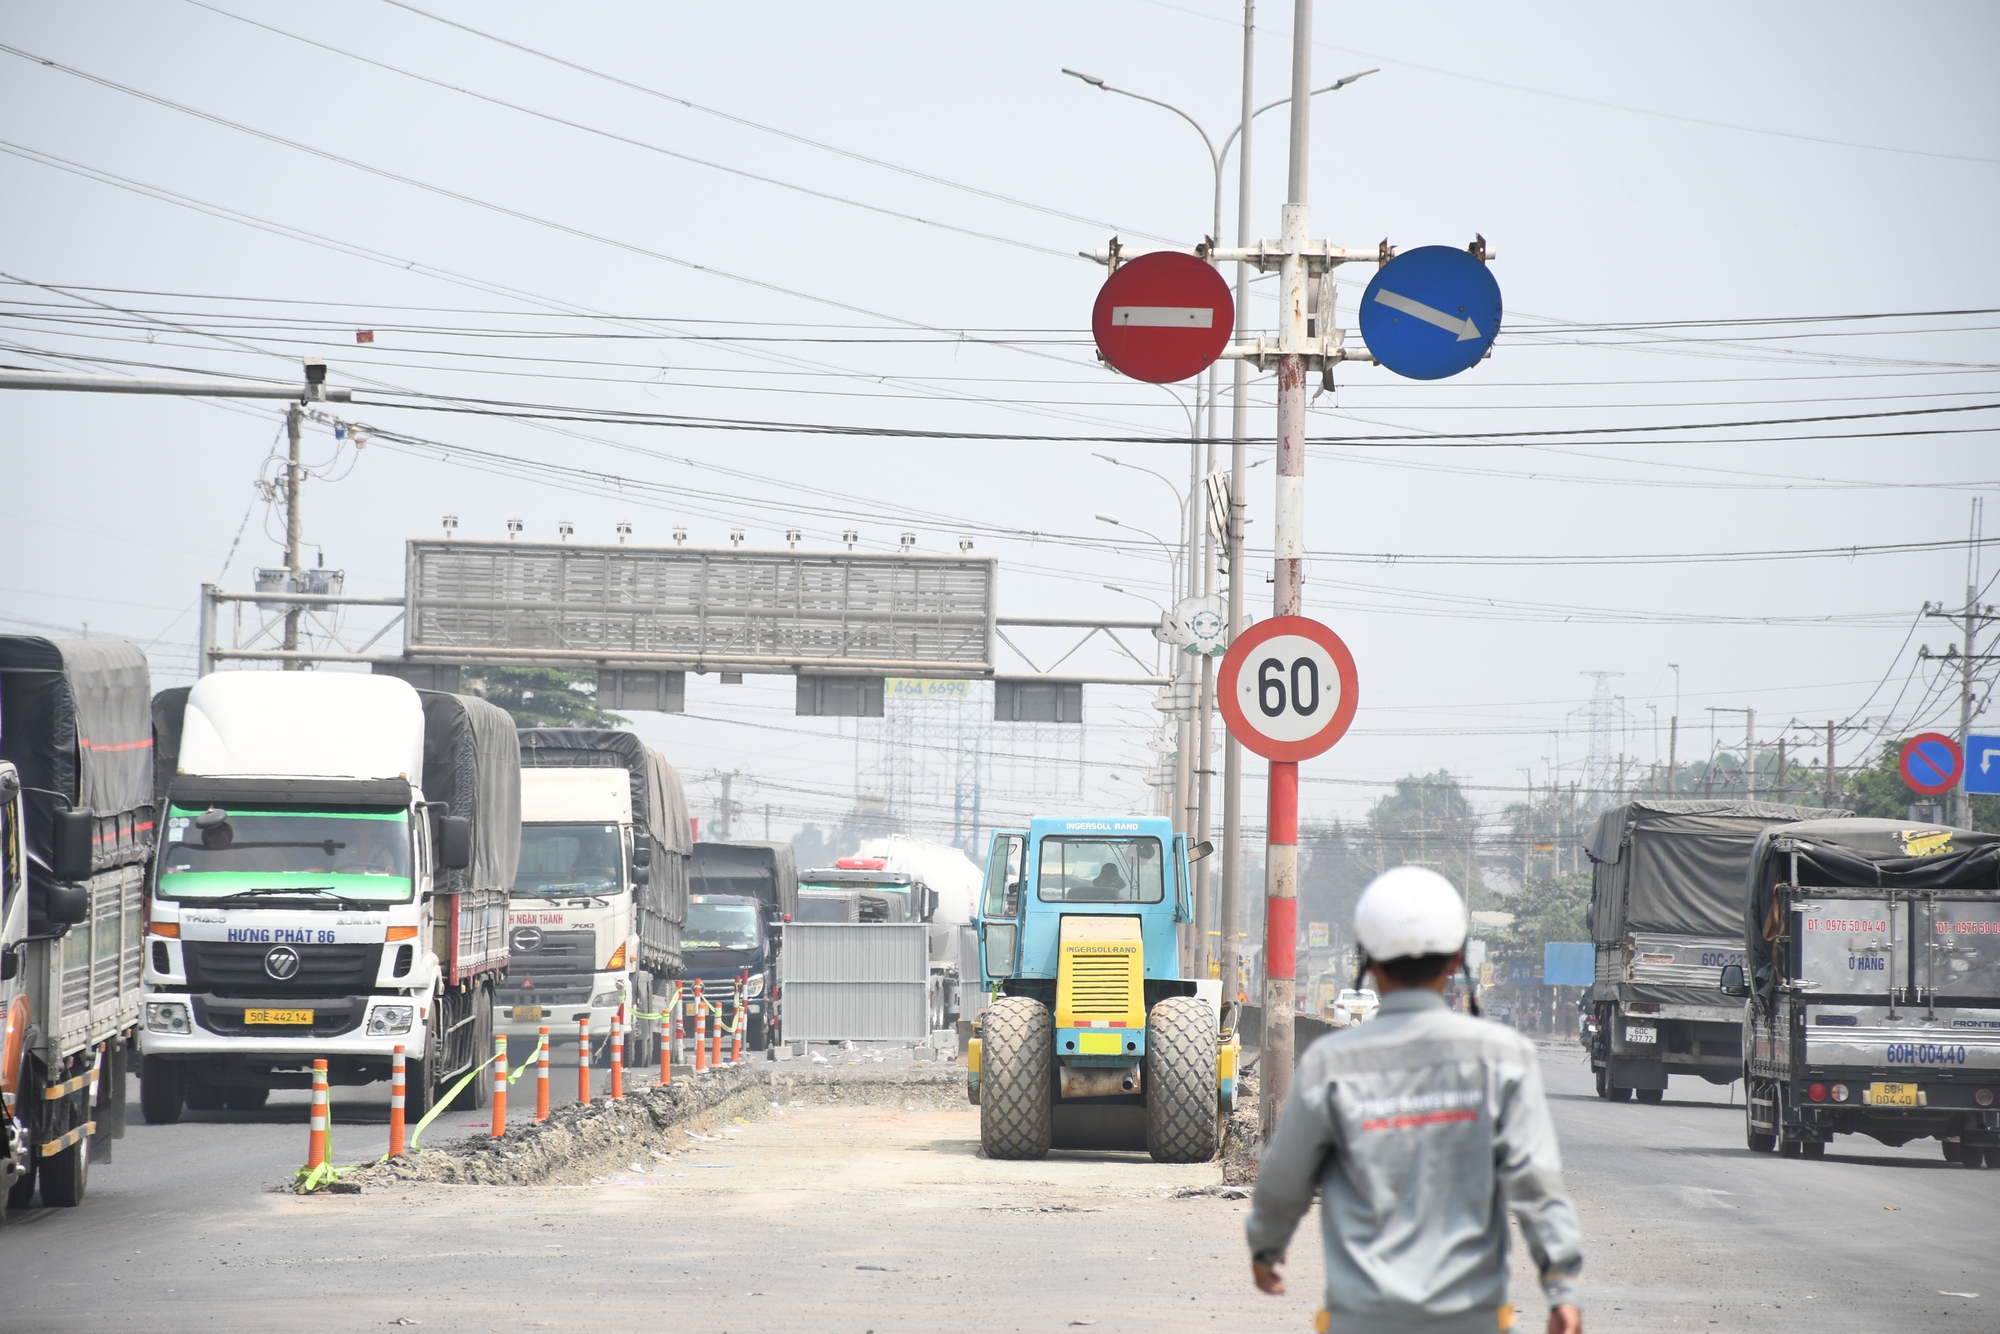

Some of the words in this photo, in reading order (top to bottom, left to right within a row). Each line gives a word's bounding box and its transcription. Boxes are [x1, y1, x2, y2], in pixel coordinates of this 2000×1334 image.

[1257, 656, 1320, 718] 60
[1825, 919, 1847, 932] 0976
[1848, 920, 1860, 932] 50
[1862, 920, 1873, 932] 04
[1875, 921, 1886, 933] 40
[1956, 922, 1977, 934] 0976
[1979, 922, 1990, 934] 50
[227, 927, 270, 942] HƯNG
[274, 927, 313, 943] PHÁT
[317, 930, 336, 943] 86
[1858, 955, 1884, 970] HÀNG
[250, 1011, 308, 1023] 50E-442.14
[1953, 1020, 2000, 1028] FRONTIE
[1634, 1027, 1649, 1035] 60C
[1884, 1084, 1904, 1094] 60H
[1876, 1095, 1912, 1105] 004.40
